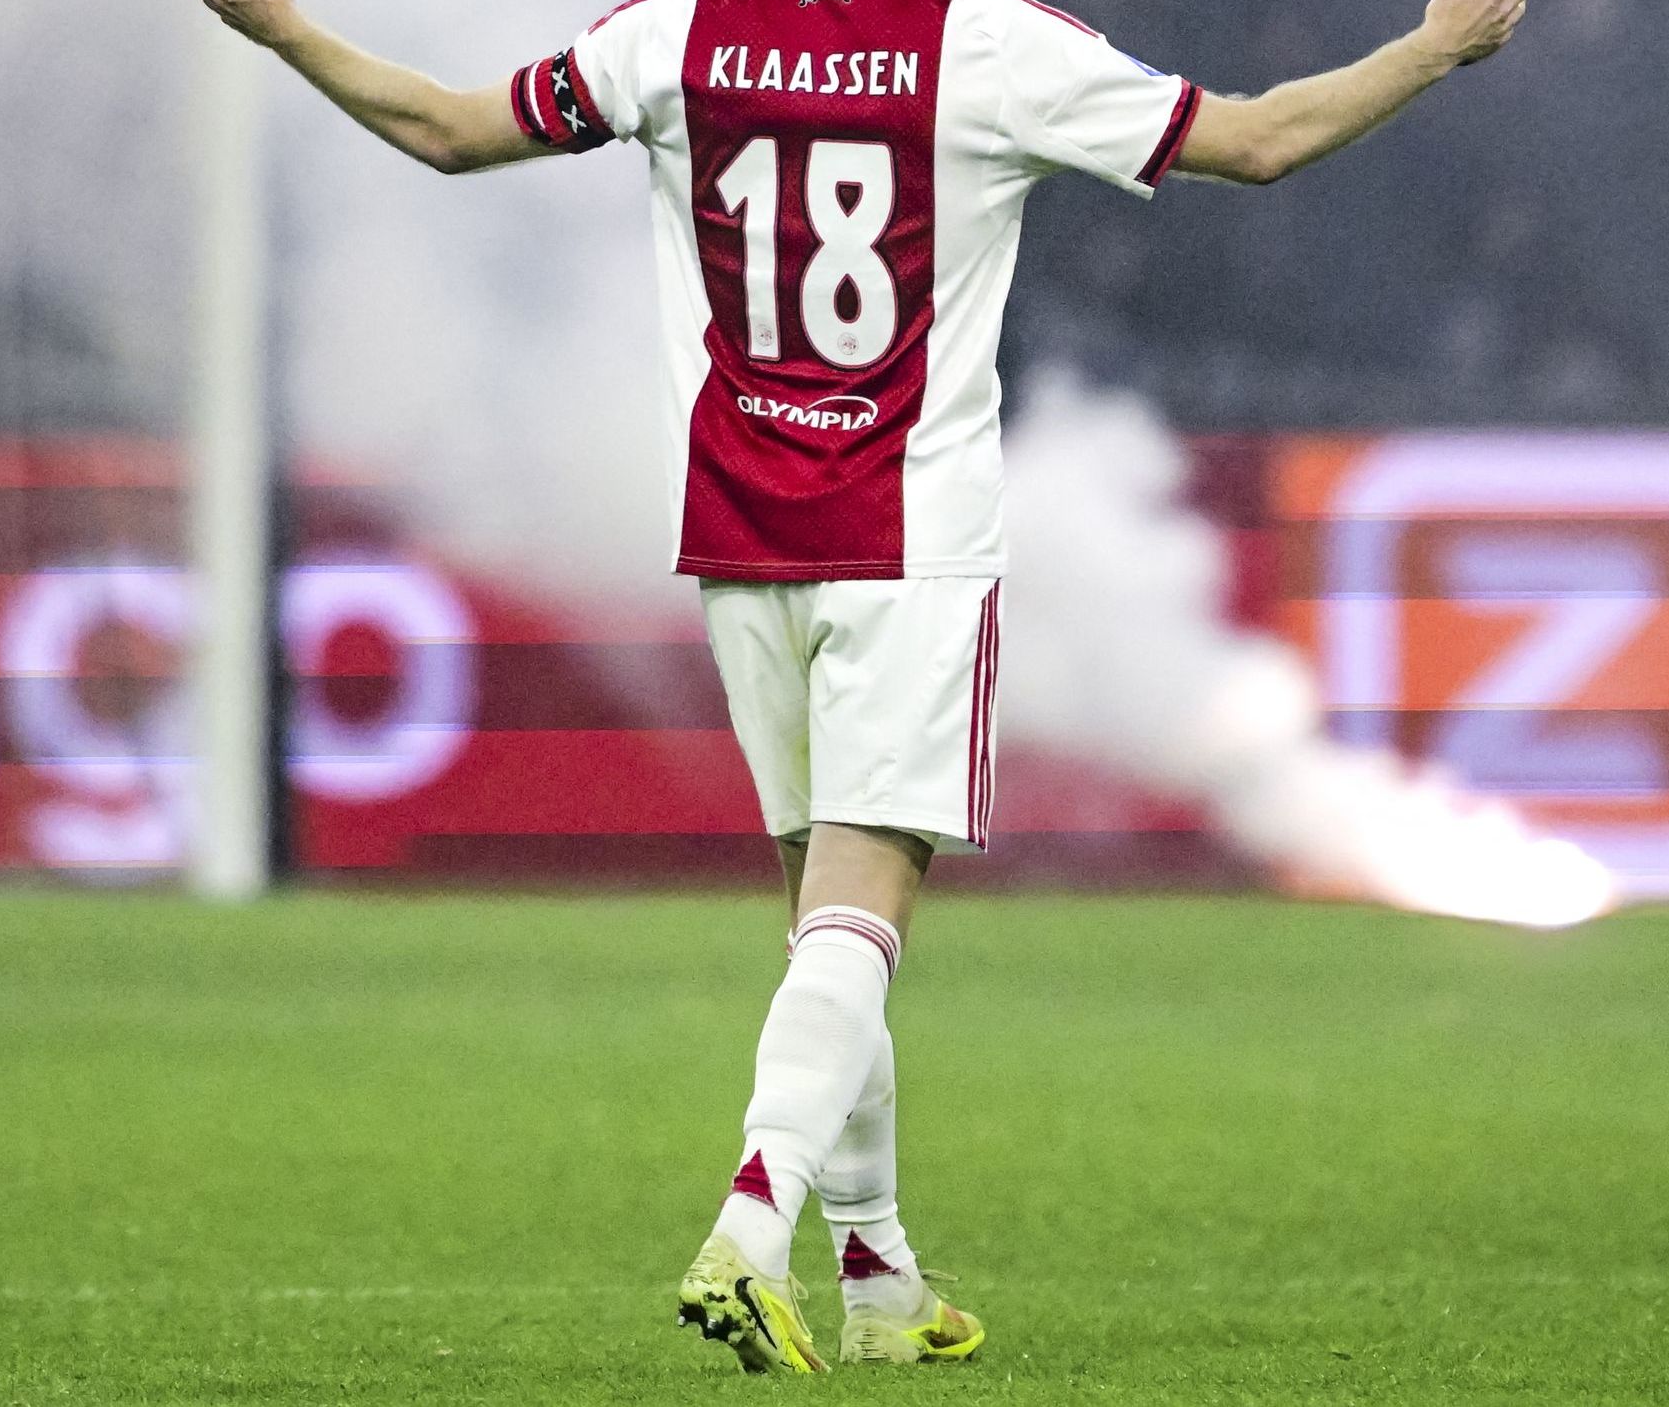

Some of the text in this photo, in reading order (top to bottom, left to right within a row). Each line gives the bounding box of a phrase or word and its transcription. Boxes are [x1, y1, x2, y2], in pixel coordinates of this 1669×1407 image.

[708, 45, 918, 95] KLAASSEN
[714, 135, 899, 369] 18
[737, 395, 878, 430] OLYMPIA
